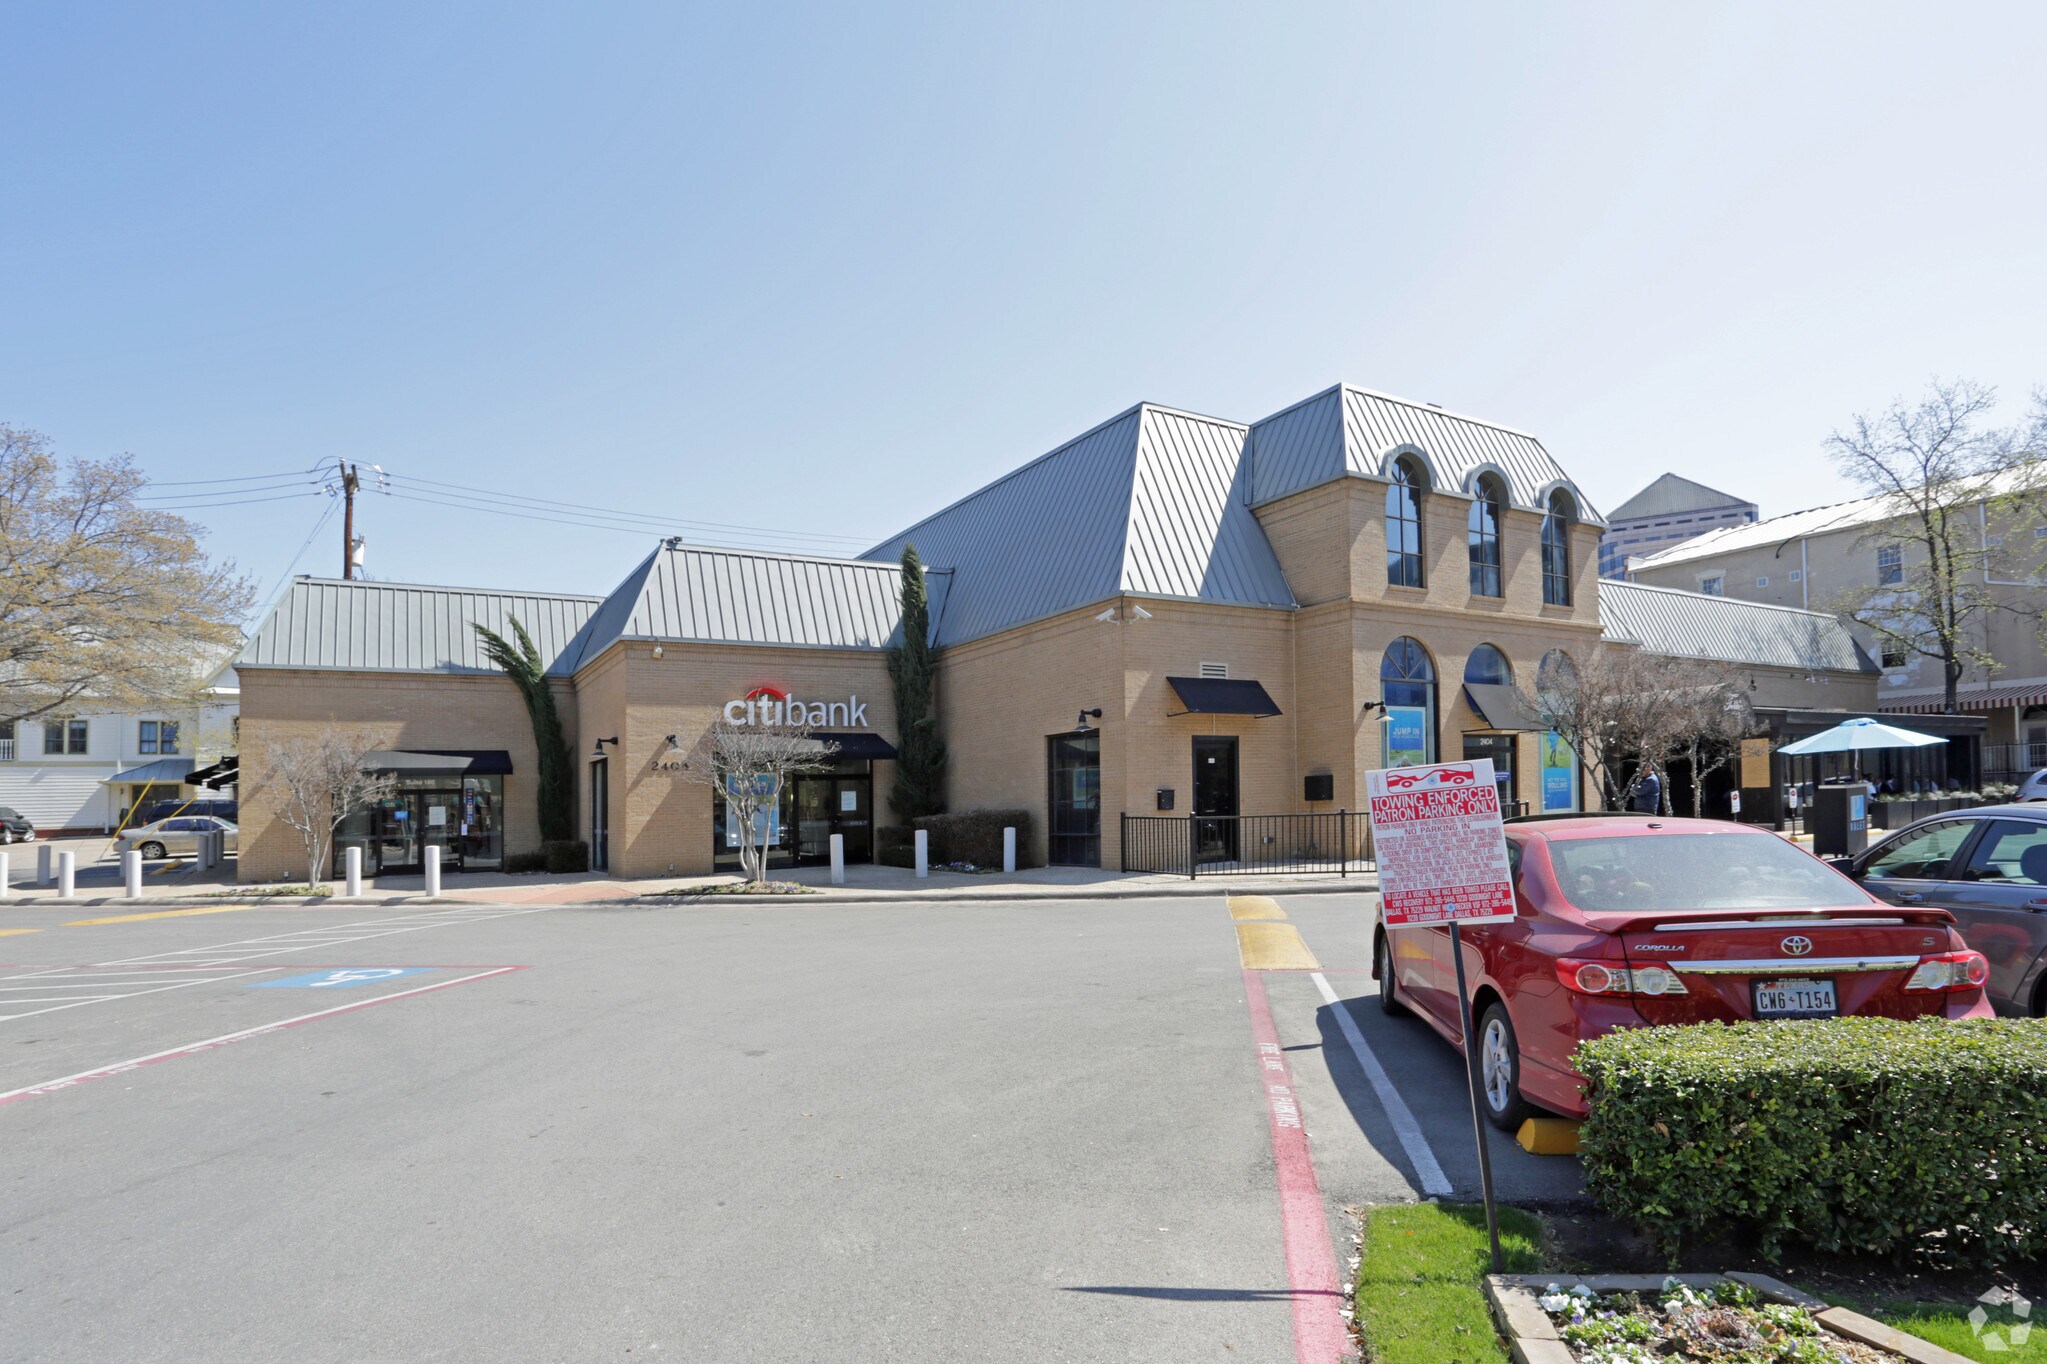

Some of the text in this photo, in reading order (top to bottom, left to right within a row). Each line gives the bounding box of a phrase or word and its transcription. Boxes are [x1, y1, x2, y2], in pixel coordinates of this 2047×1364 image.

[723, 693, 868, 727] citibank
[1393, 727, 1420, 735] JUMP IN
[1372, 786, 1495, 810] TOWING ENFORCED
[1374, 798, 1496, 823] PATRON PARKING ONLY
[1375, 823, 1390, 831] PATRON
[1431, 817, 1456, 825] PATRONIZING
[1420, 823, 1458, 833] PARKING
[1850, 820, 1865, 832] VALET
[1412, 890, 1429, 898] VEHICLE
[1464, 885, 1479, 893] TOWED
[1479, 884, 1496, 892] PLEASE
[1403, 898, 1424, 906] RECOVERY
[1452, 901, 1472, 909] RECKER
[1922, 936, 1936, 946] S
[1760, 990, 1832, 1009] CW6 T154
[1272, 1097, 1302, 1129] PARKING
